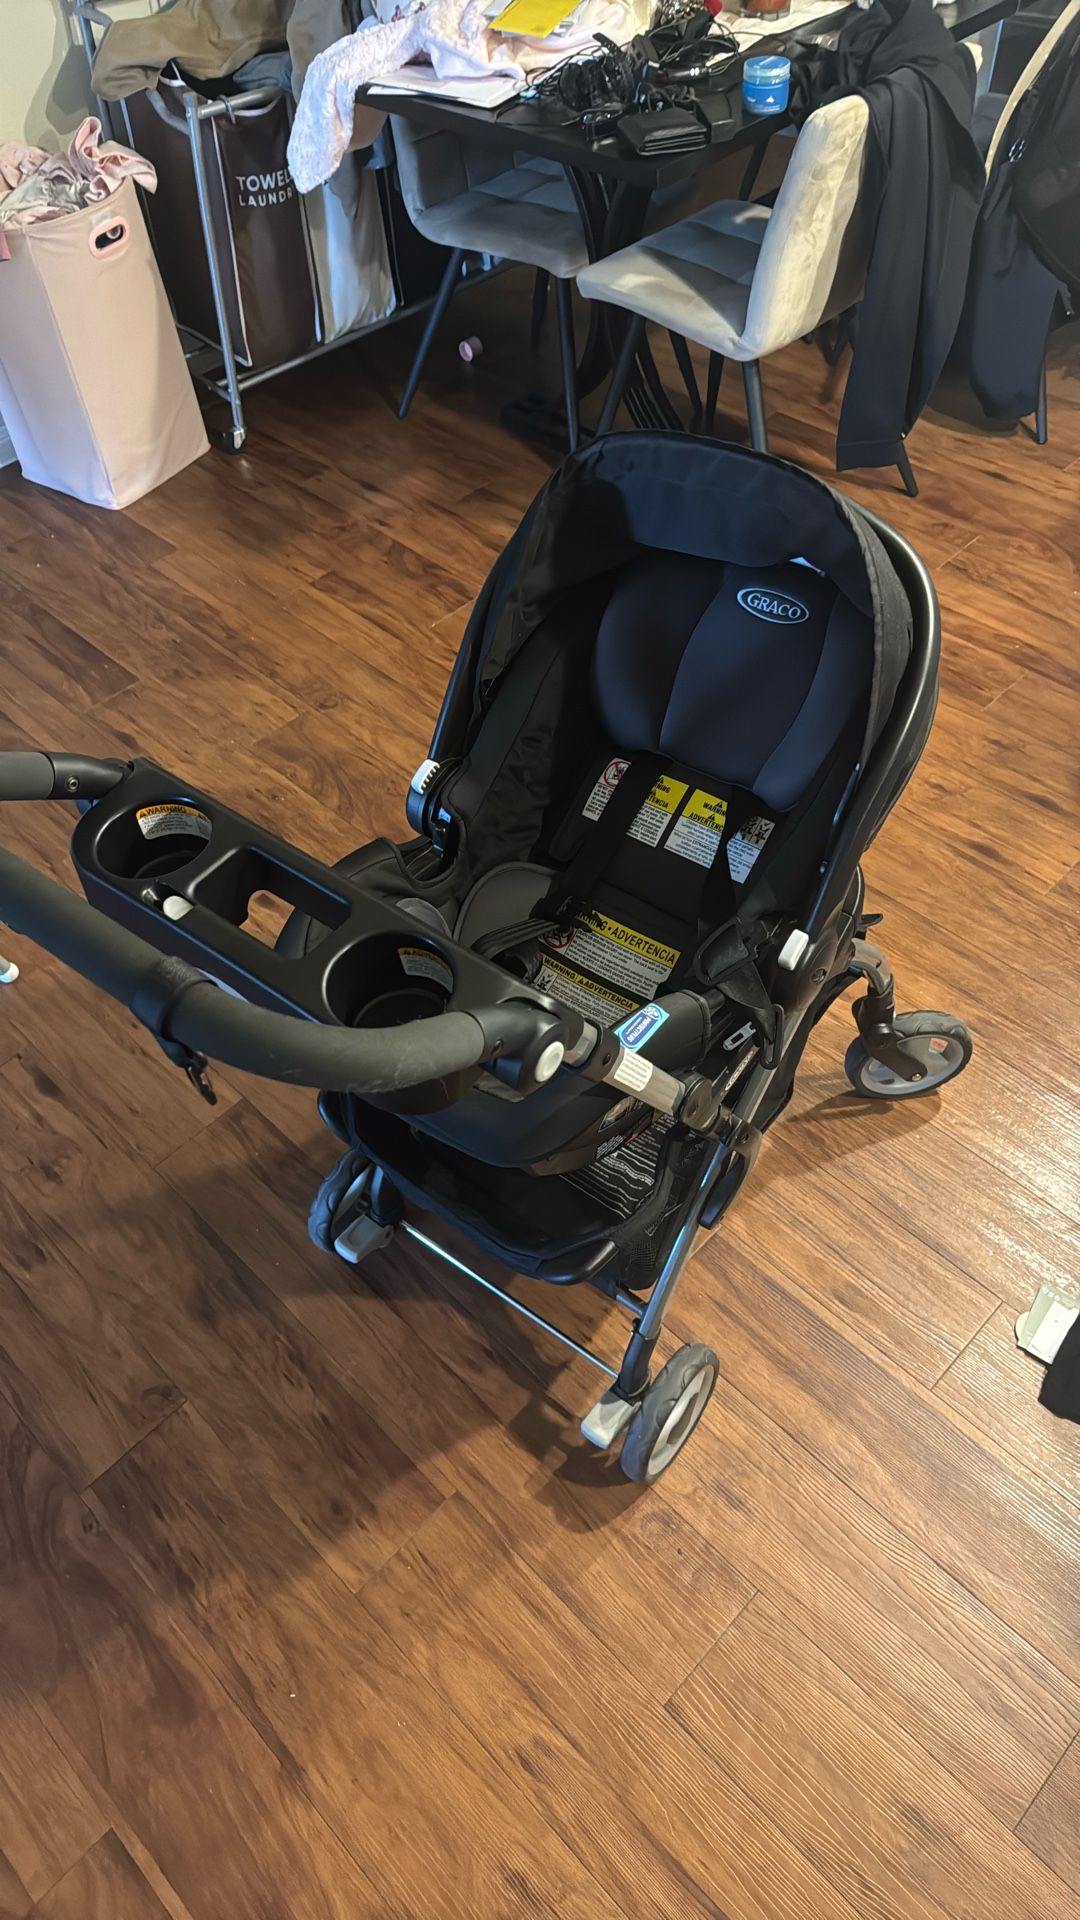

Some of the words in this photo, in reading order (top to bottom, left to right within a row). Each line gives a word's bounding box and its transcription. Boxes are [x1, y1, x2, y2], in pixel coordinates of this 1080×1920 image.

[239, 187, 293, 207] LAUNDR
[747, 593, 801, 619] GRACO
[655, 783, 671, 794] NING
[146, 805, 186, 816] WARNING
[703, 801, 727, 817] WARNIN
[689, 812, 724, 831] ADVERTENC
[611, 927, 676, 965] ADVERTENCIA
[543, 957, 576, 980] WARNING
[583, 979, 634, 1010] ADVERTENCIA
